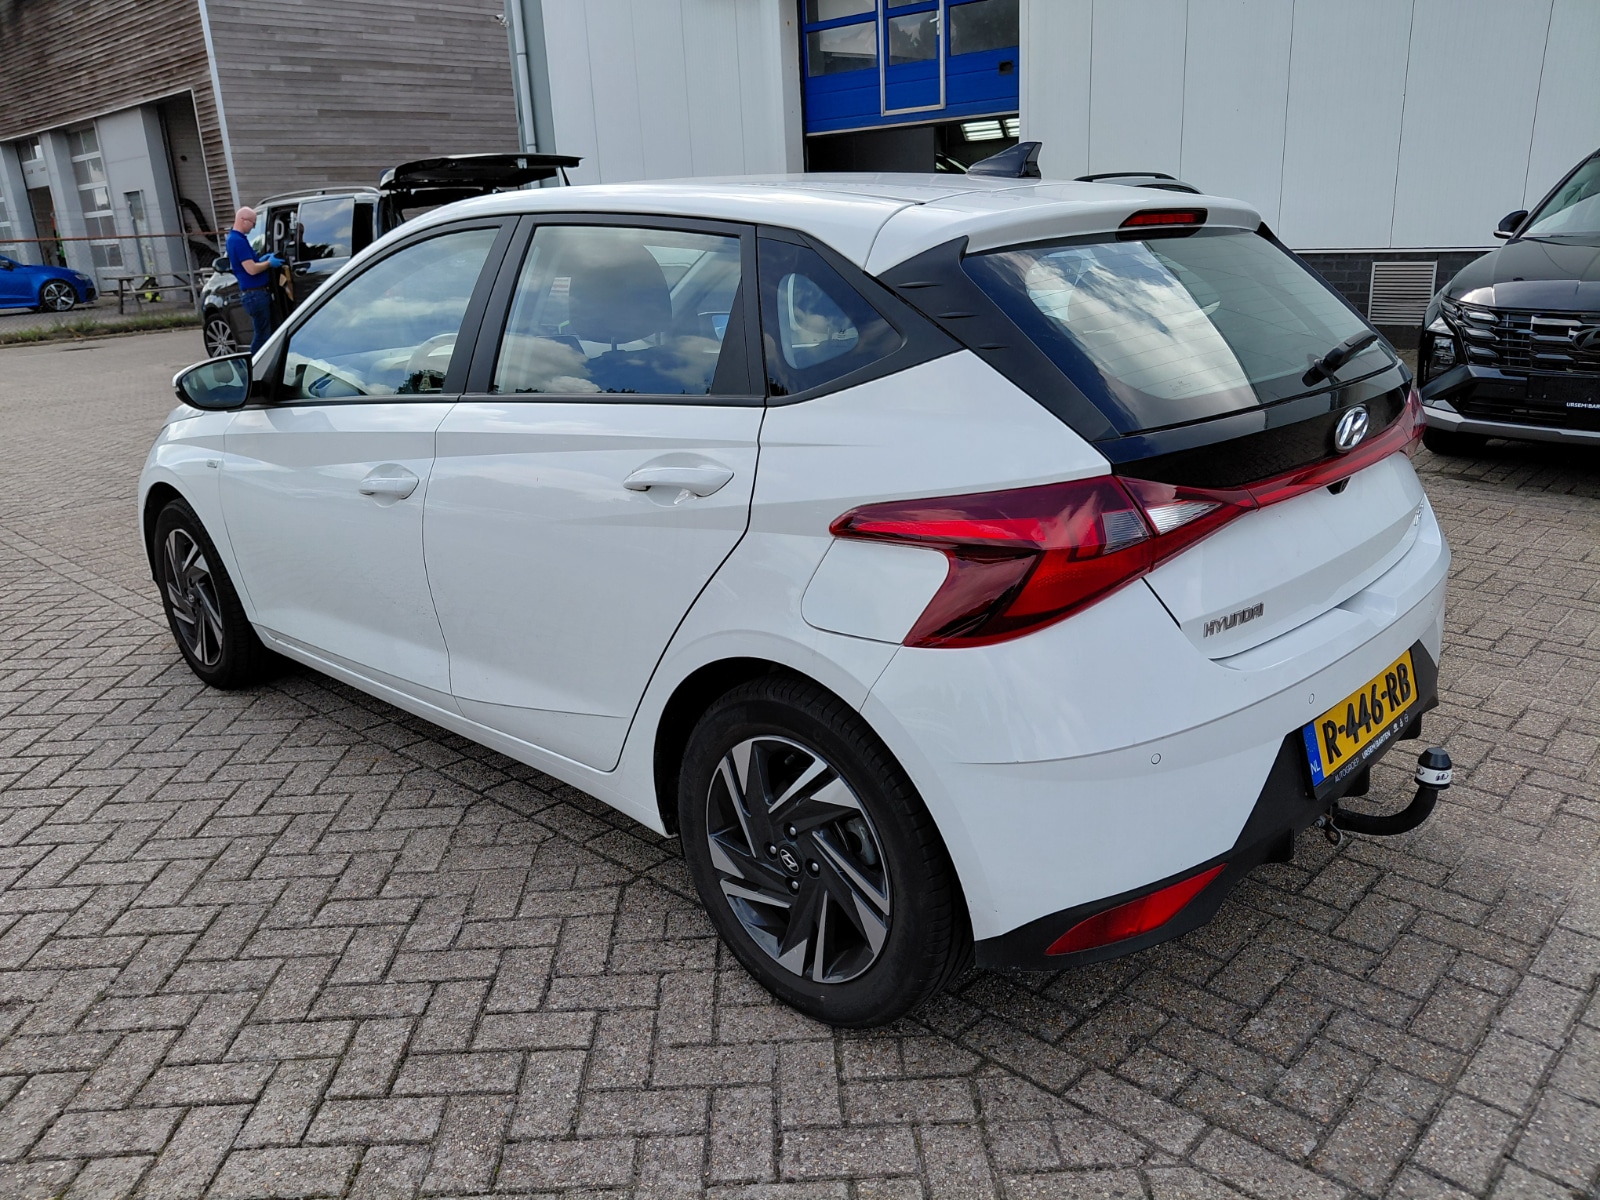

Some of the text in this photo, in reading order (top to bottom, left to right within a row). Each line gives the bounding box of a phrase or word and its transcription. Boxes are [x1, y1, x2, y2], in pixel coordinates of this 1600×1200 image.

[1203, 602, 1264, 638] HYUNDAI
[1322, 663, 1411, 765] R-446-RB
[1310, 759, 1321, 776] NL
